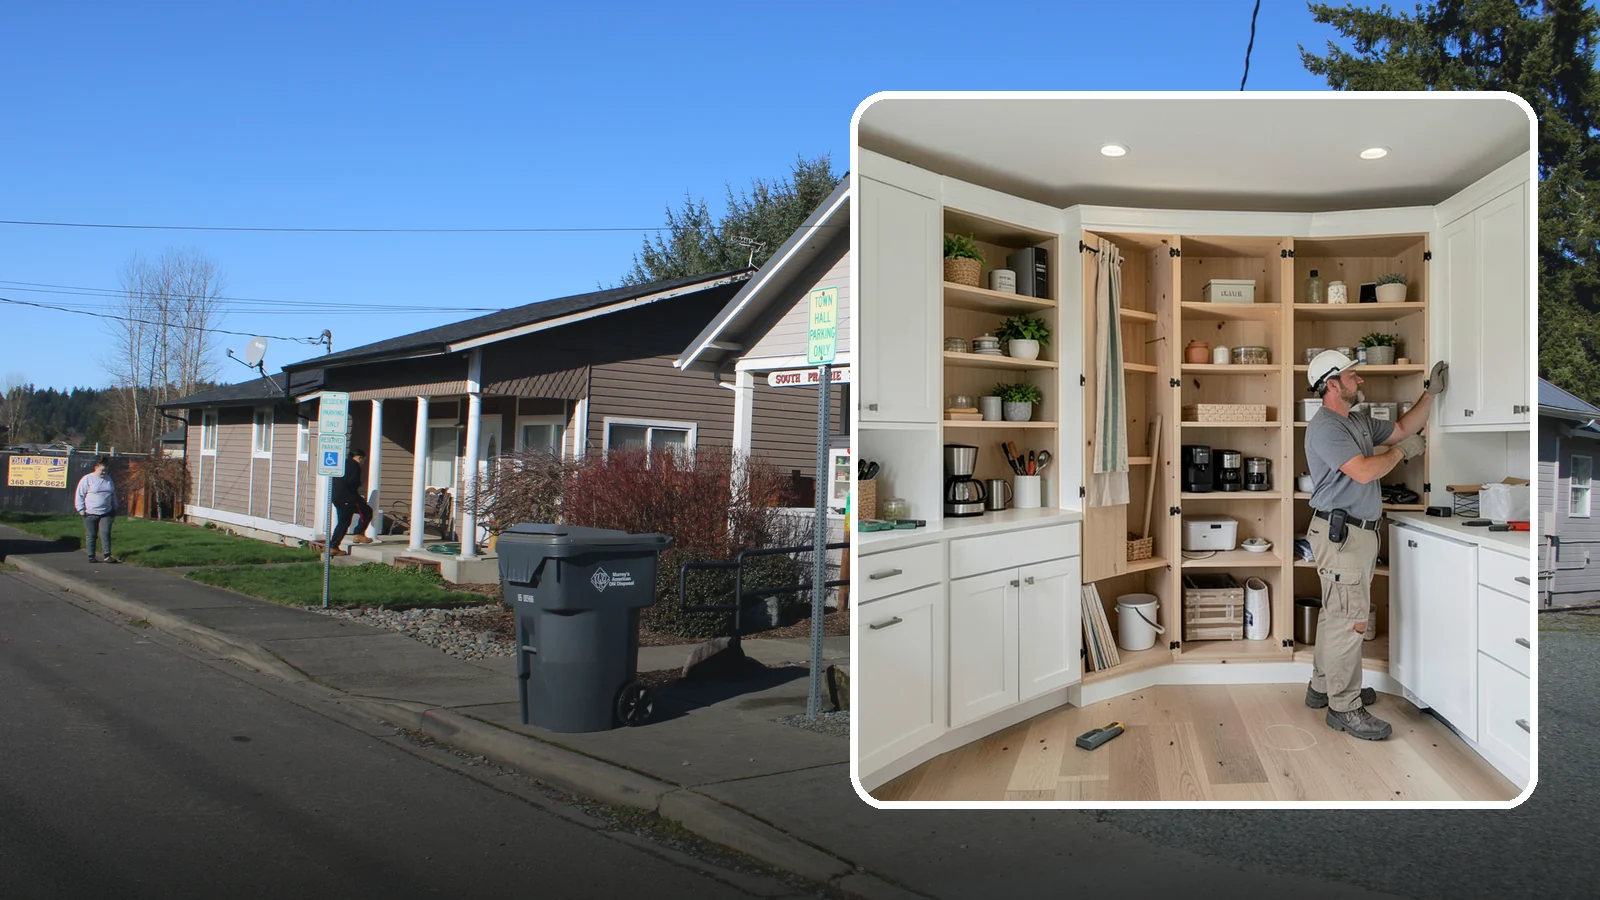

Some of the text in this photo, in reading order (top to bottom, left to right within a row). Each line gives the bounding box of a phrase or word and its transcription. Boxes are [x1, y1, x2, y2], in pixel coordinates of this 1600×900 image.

[815, 294, 833, 308] TOWN
[814, 311, 831, 324] HALL
[810, 326, 835, 340] PARKING
[813, 344, 831, 357] ONLY
[775, 370, 842, 384] SOUTH PRIE
